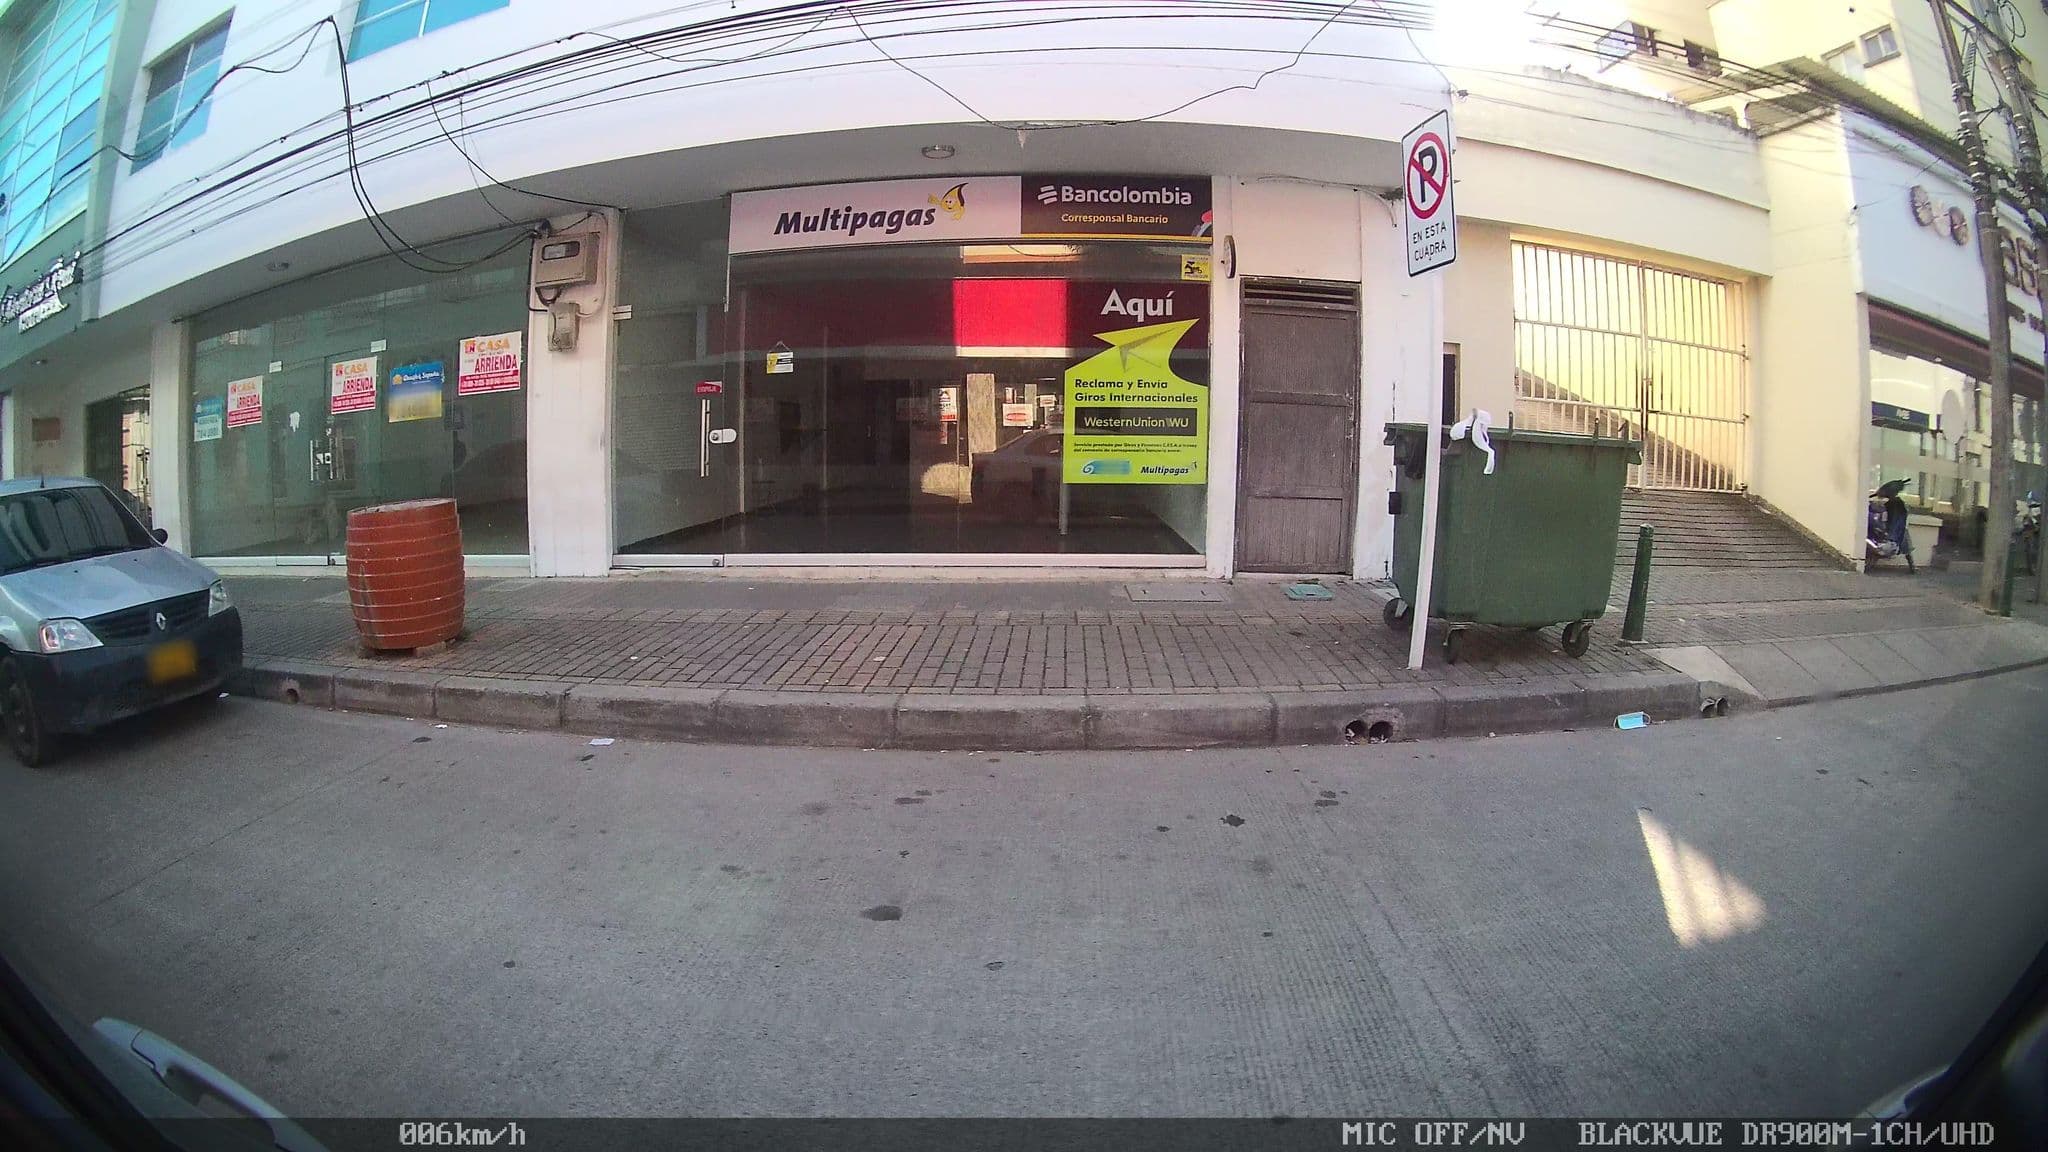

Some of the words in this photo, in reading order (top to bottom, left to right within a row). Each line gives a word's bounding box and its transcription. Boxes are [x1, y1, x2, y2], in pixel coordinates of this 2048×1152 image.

[1061, 185, 1192, 205] Bancolombia
[774, 206, 936, 236] Multipagas
[1061, 213, 1125, 224] Corresponsal
[1127, 214, 1169, 224] Bancario
[1413, 232, 1423, 244] EN
[1425, 221, 1447, 239] ESTA
[1414, 240, 1447, 261] CUADRA
[1101, 288, 1175, 322] Aquí
[477, 337, 510, 352] CASA
[475, 354, 518, 373] ARRIENDA
[343, 377, 374, 394] ARRIENDA
[1075, 379, 1123, 388] Reclama
[1127, 381, 1133, 390] y
[1075, 393, 1105, 402] Giros
[1110, 393, 1198, 403] Internacionales
[1141, 466, 1189, 476] Multipagas
